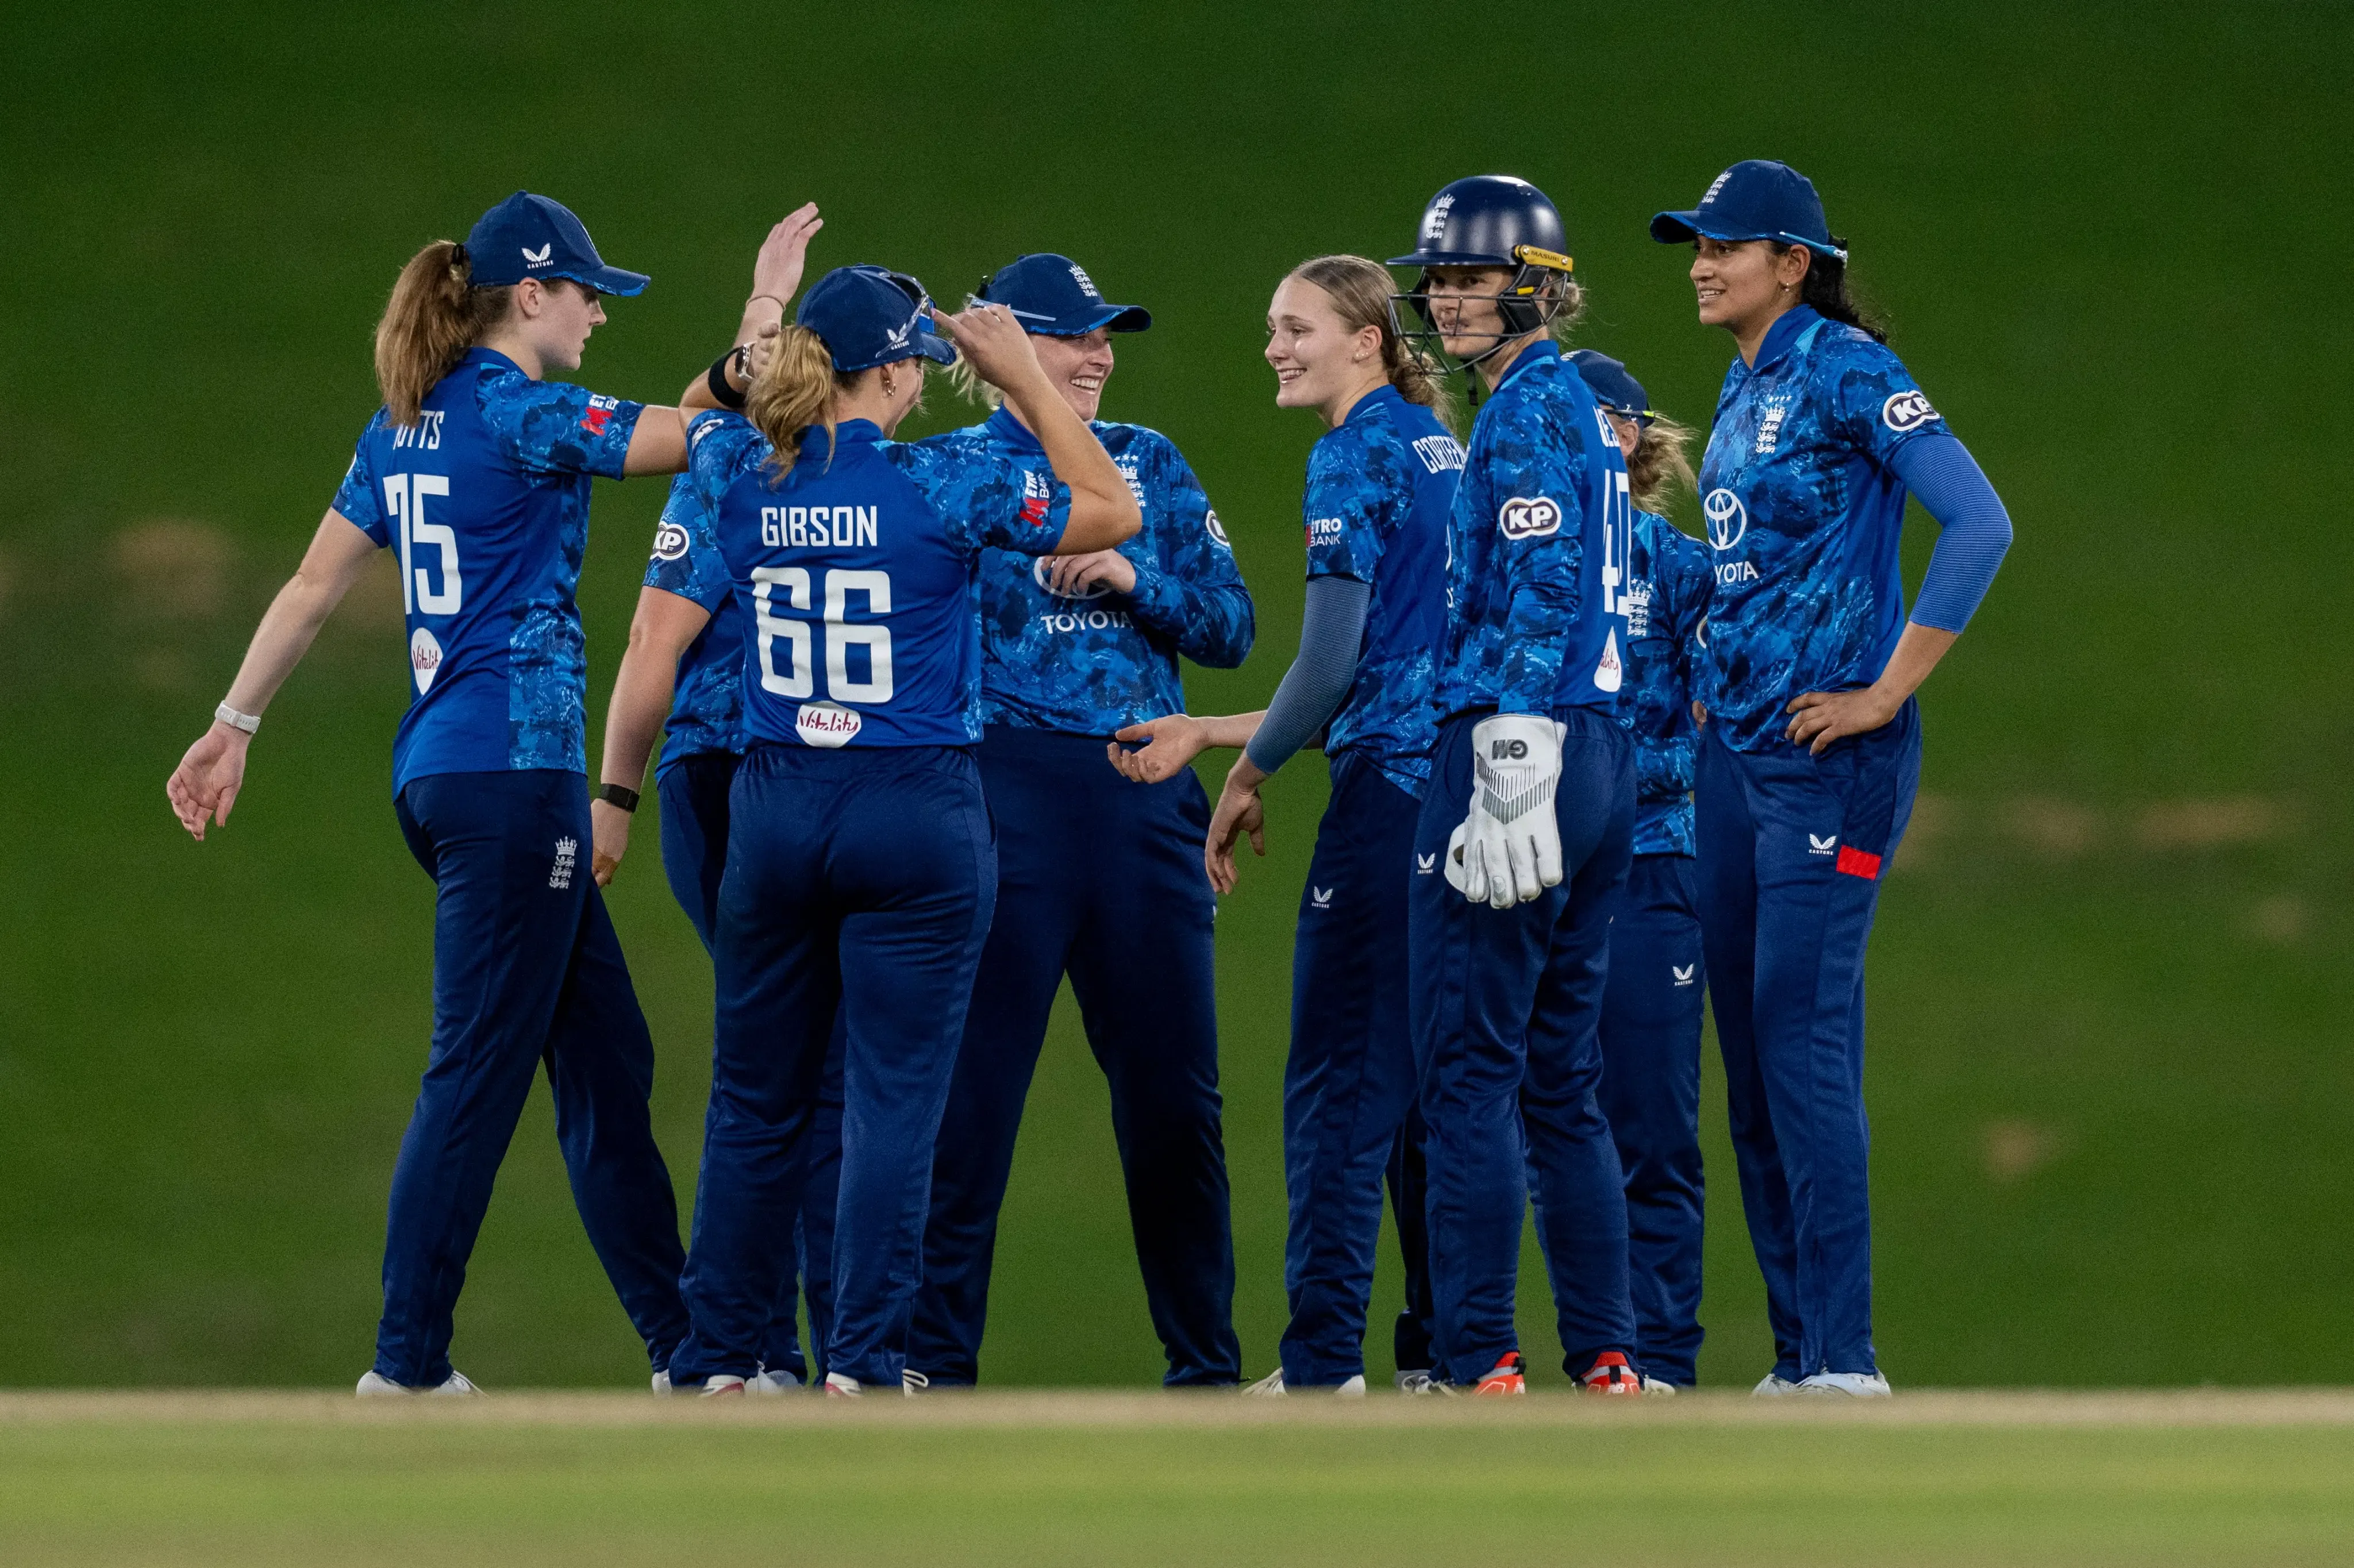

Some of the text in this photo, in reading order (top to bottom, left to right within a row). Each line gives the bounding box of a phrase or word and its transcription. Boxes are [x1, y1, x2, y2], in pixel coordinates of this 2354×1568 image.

[761, 506, 877, 546] GIBSON
[1509, 506, 1552, 530] KP
[383, 473, 461, 615] 75
[1714, 561, 1759, 584] YOTA
[751, 567, 893, 703] 66
[1040, 610, 1134, 634] TOYOTA
[413, 644, 439, 671] Vitalit
[1599, 648, 1619, 679] ality
[799, 710, 859, 735] Vitality
